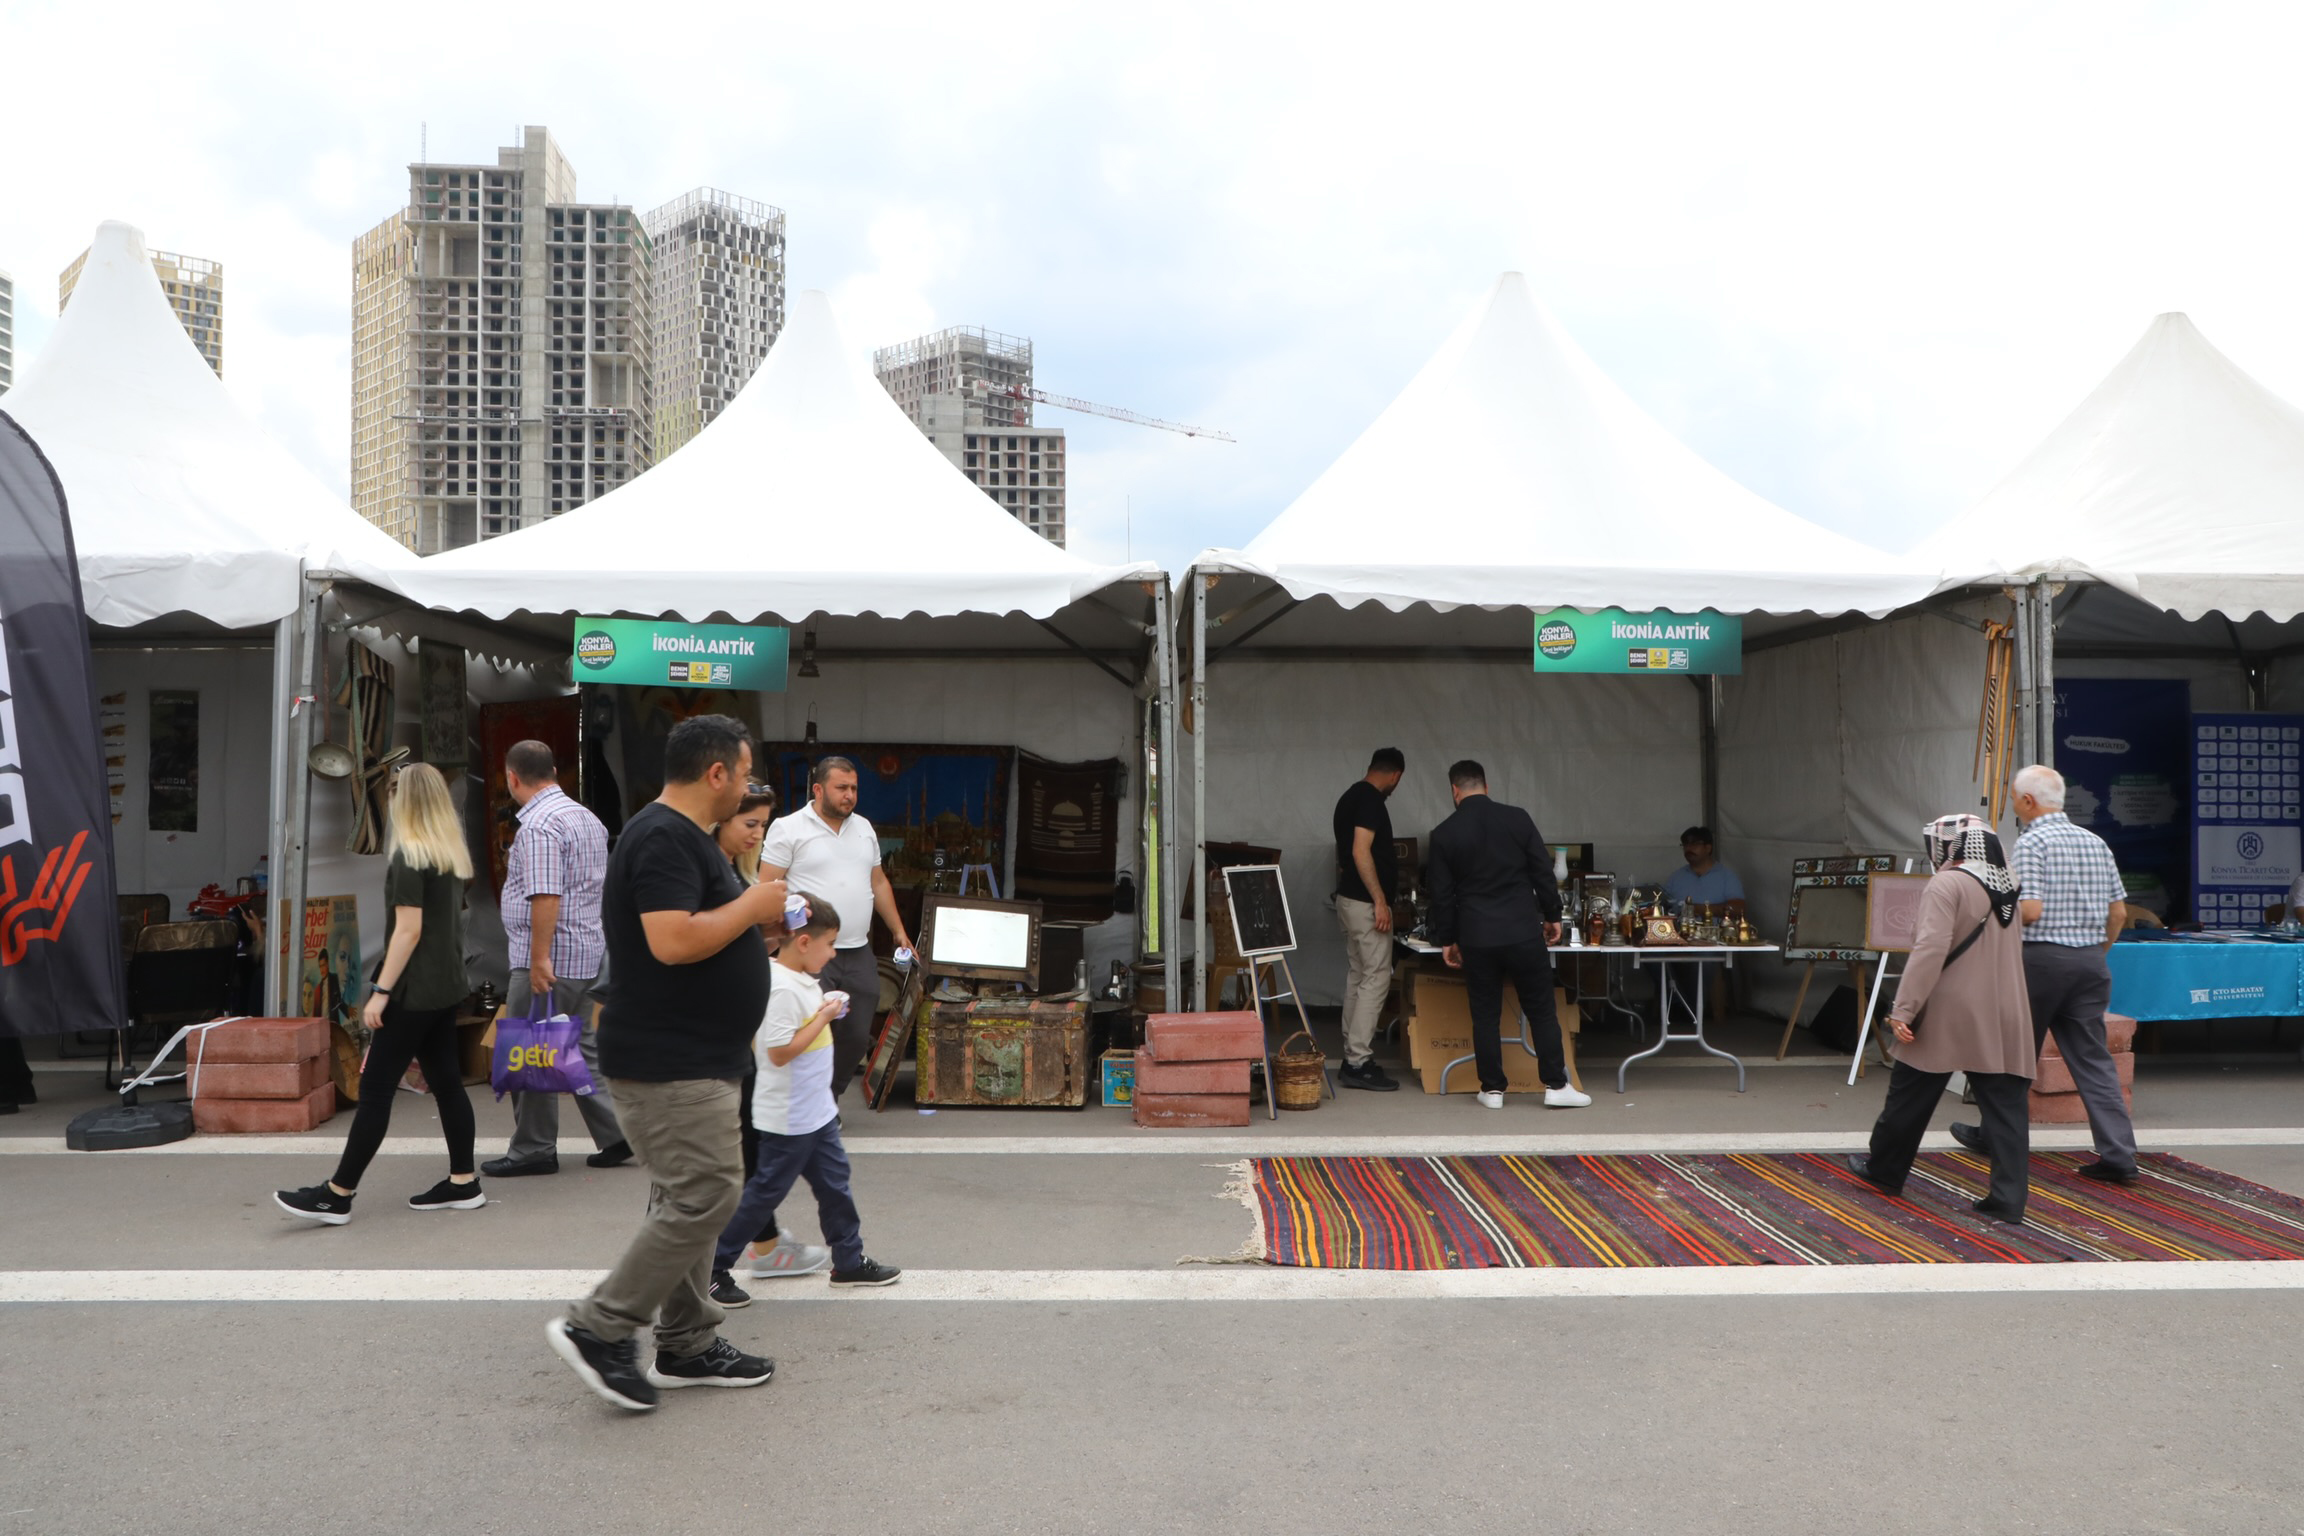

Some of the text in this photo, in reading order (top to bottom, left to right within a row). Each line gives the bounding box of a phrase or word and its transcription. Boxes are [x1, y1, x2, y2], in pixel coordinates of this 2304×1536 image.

[1539, 630, 1574, 642] GÜNLERİ
[1541, 625, 1570, 635] KONYA
[1612, 620, 1711, 640] İKONİA ANTİK
[578, 640, 614, 652] GÜNLERİ
[581, 636, 610, 645] KONYA
[653, 633, 755, 656] İKONİA ANTİK
[2211, 865, 2237, 874] KONYA
[2230, 986, 2264, 994] KARATAY
[507, 1043, 559, 1072] getir
